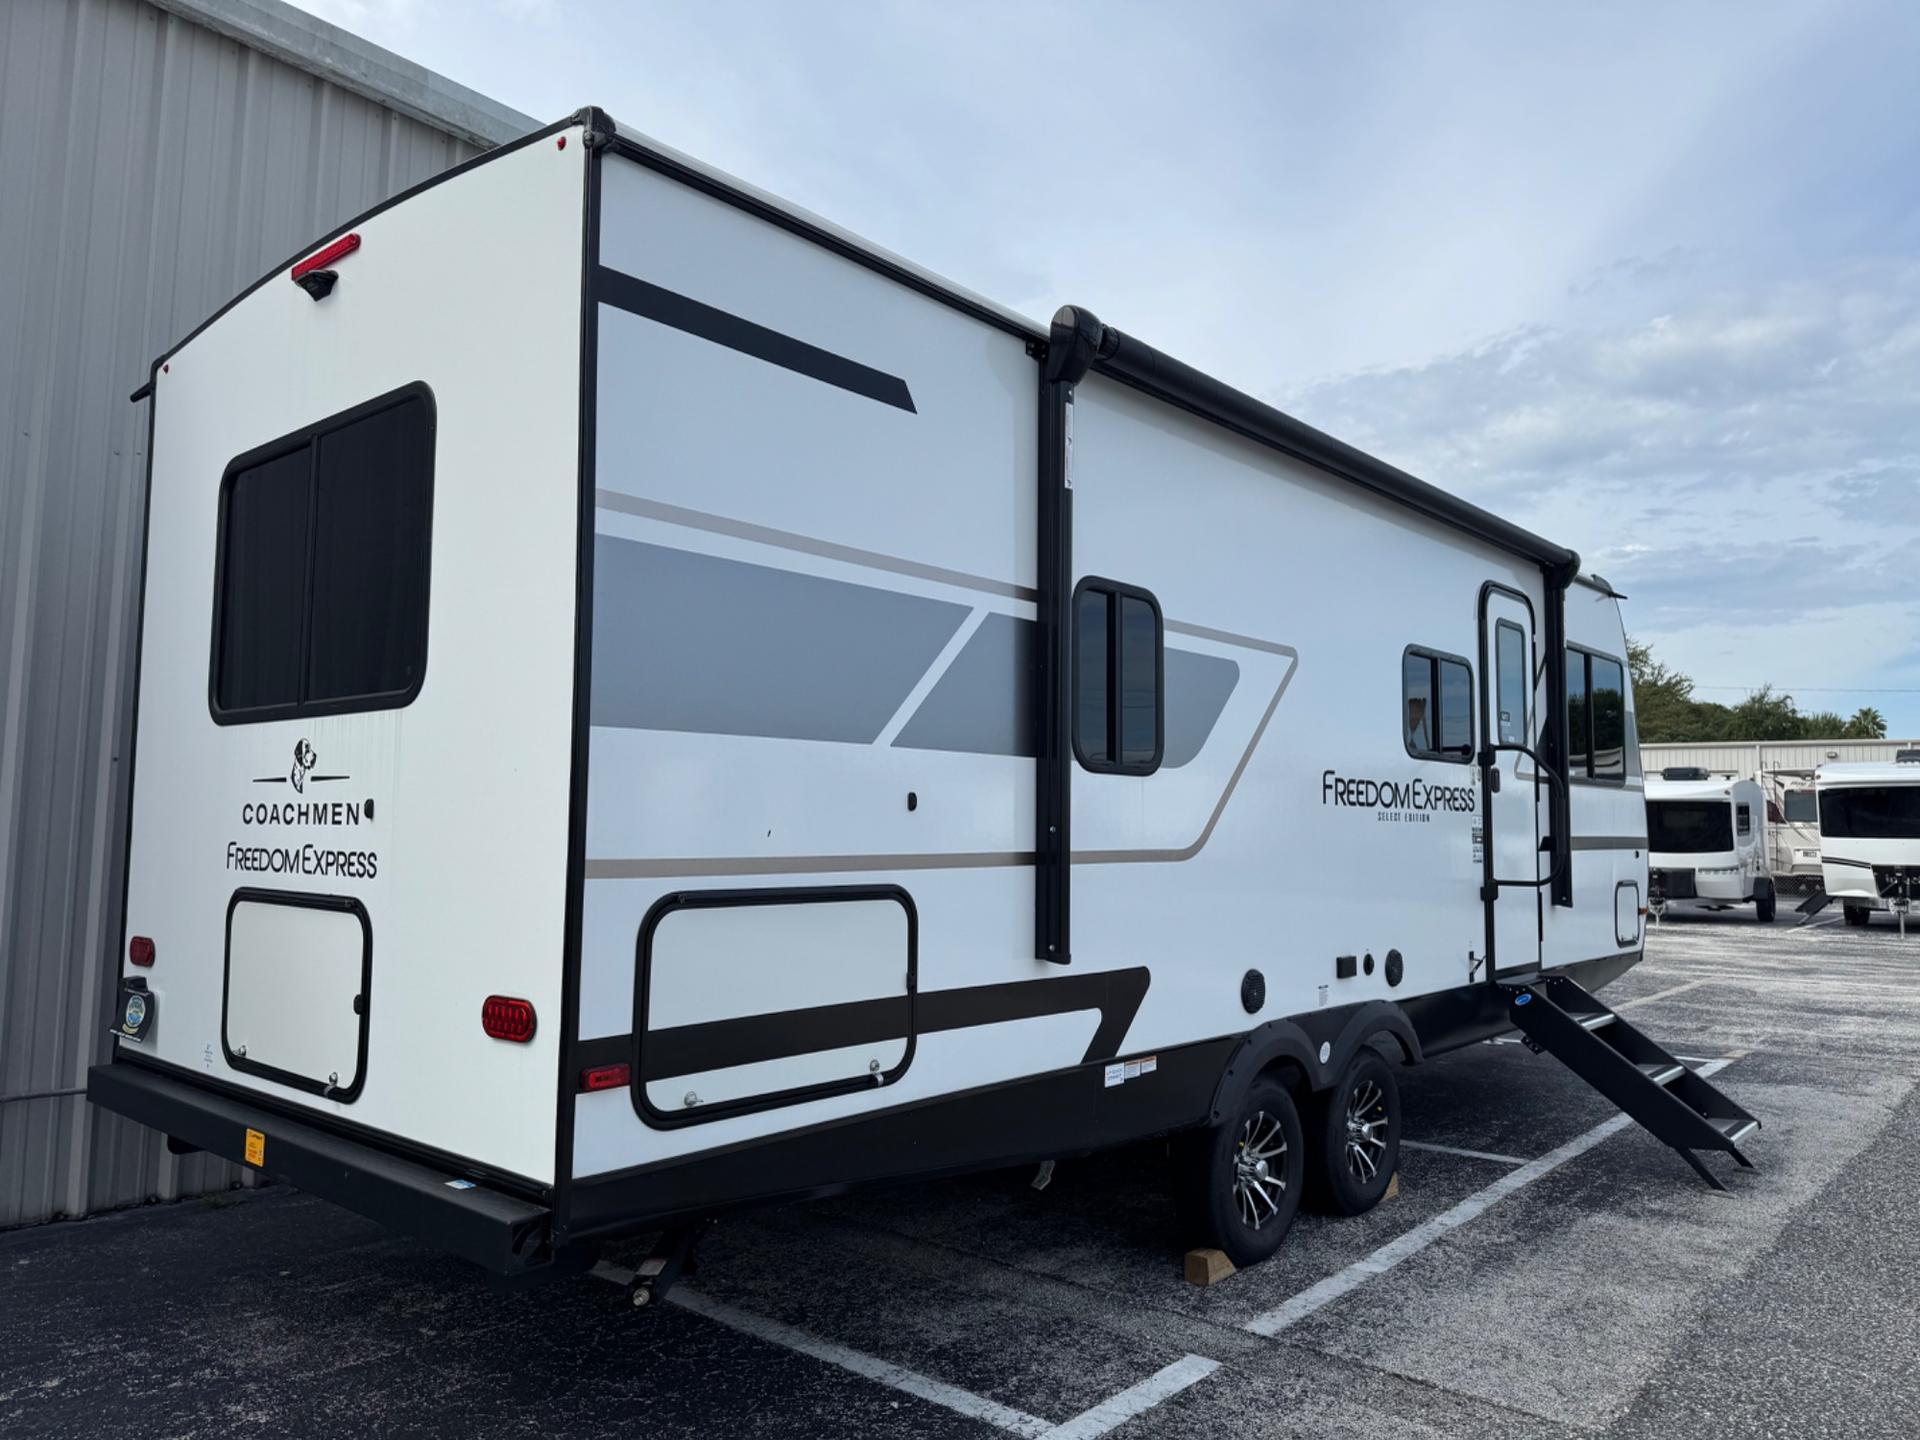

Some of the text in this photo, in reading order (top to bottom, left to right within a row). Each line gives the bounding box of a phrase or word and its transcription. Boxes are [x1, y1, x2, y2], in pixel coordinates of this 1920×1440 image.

[242, 803, 360, 825] COACHMEN
[1377, 811, 1430, 823] SELECT EDITION
